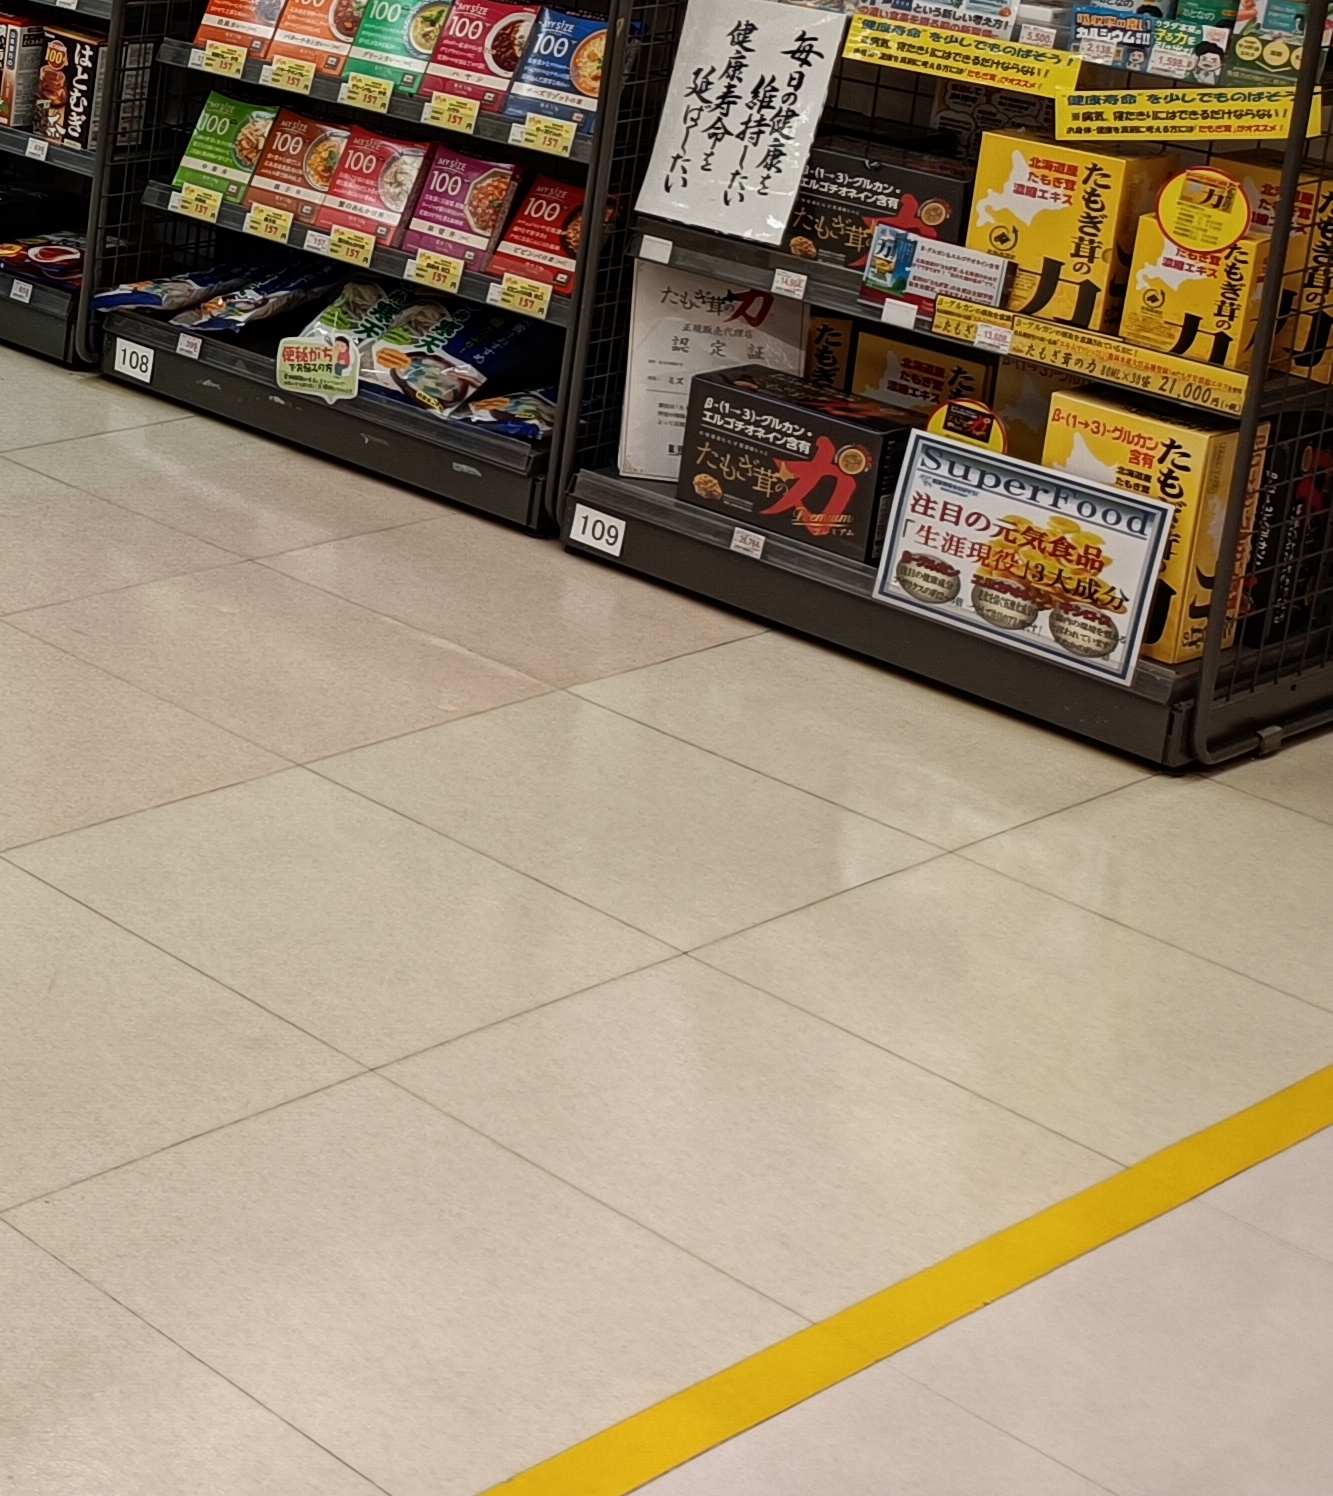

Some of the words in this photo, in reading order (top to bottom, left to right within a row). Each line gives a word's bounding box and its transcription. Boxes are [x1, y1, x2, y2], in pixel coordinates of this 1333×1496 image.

[368, 3, 401, 23] 100
[448, 18, 483, 39] 100
[533, 35, 569, 57] 100
[68, 43, 93, 137] はとむぎ
[700, 20, 759, 172] 健康寿命を
[200, 114, 230, 135] 100
[756, 30, 825, 196] 毎日の健康を
[273, 132, 304, 154] 100
[664, 66, 717, 193] 延ばしたい
[724, 75, 779, 206] 維持したい
[344, 150, 376, 174] 100
[431, 171, 463, 195] 100
[523, 198, 561, 222] 100
[1069, 162, 1112, 275] たもぎ茸の
[120, 347, 150, 375] 108
[920, 445, 1151, 537] SuperFood
[578, 514, 621, 548] 109
[910, 490, 1105, 574] 注目の元気食品
